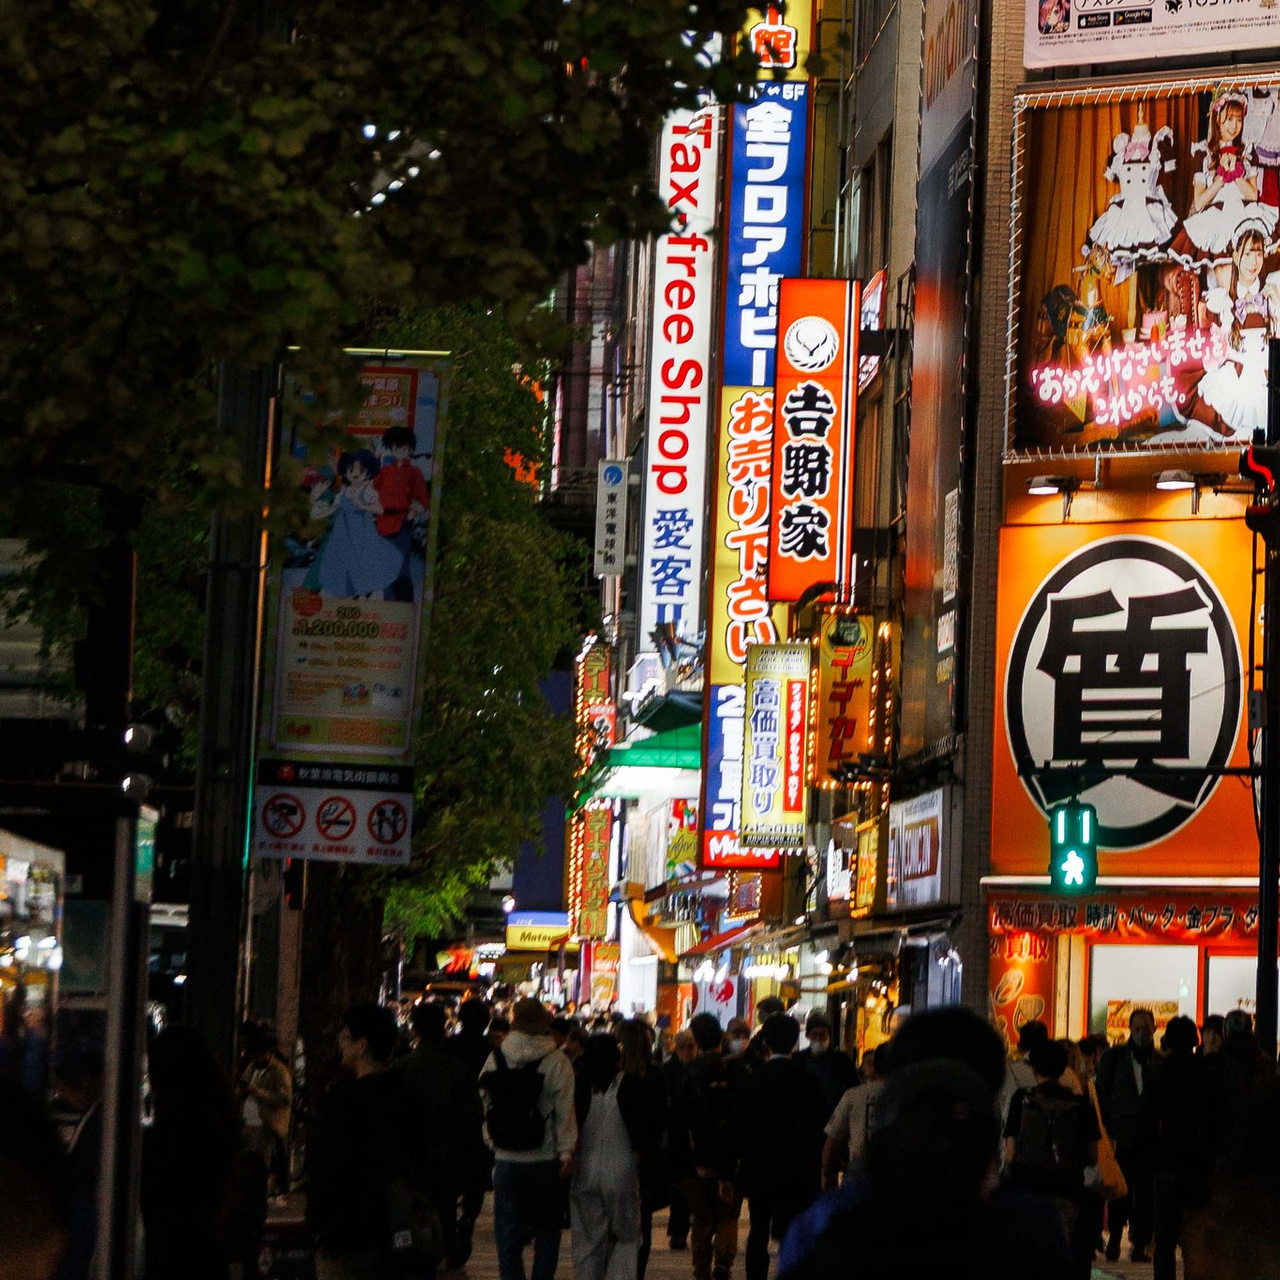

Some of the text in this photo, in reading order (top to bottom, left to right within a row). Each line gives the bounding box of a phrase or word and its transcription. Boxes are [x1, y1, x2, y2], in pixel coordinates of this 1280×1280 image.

[651, 114, 712, 495] Tax-free Shop
[738, 100, 793, 387] 全フロアホビー
[780, 382, 837, 560] 吉野家
[1096, 375, 1186, 426] これからも。
[727, 391, 778, 668] お売り下さい
[750, 678, 782, 815] 高価買取り
[1036, 580, 1212, 808] 質
